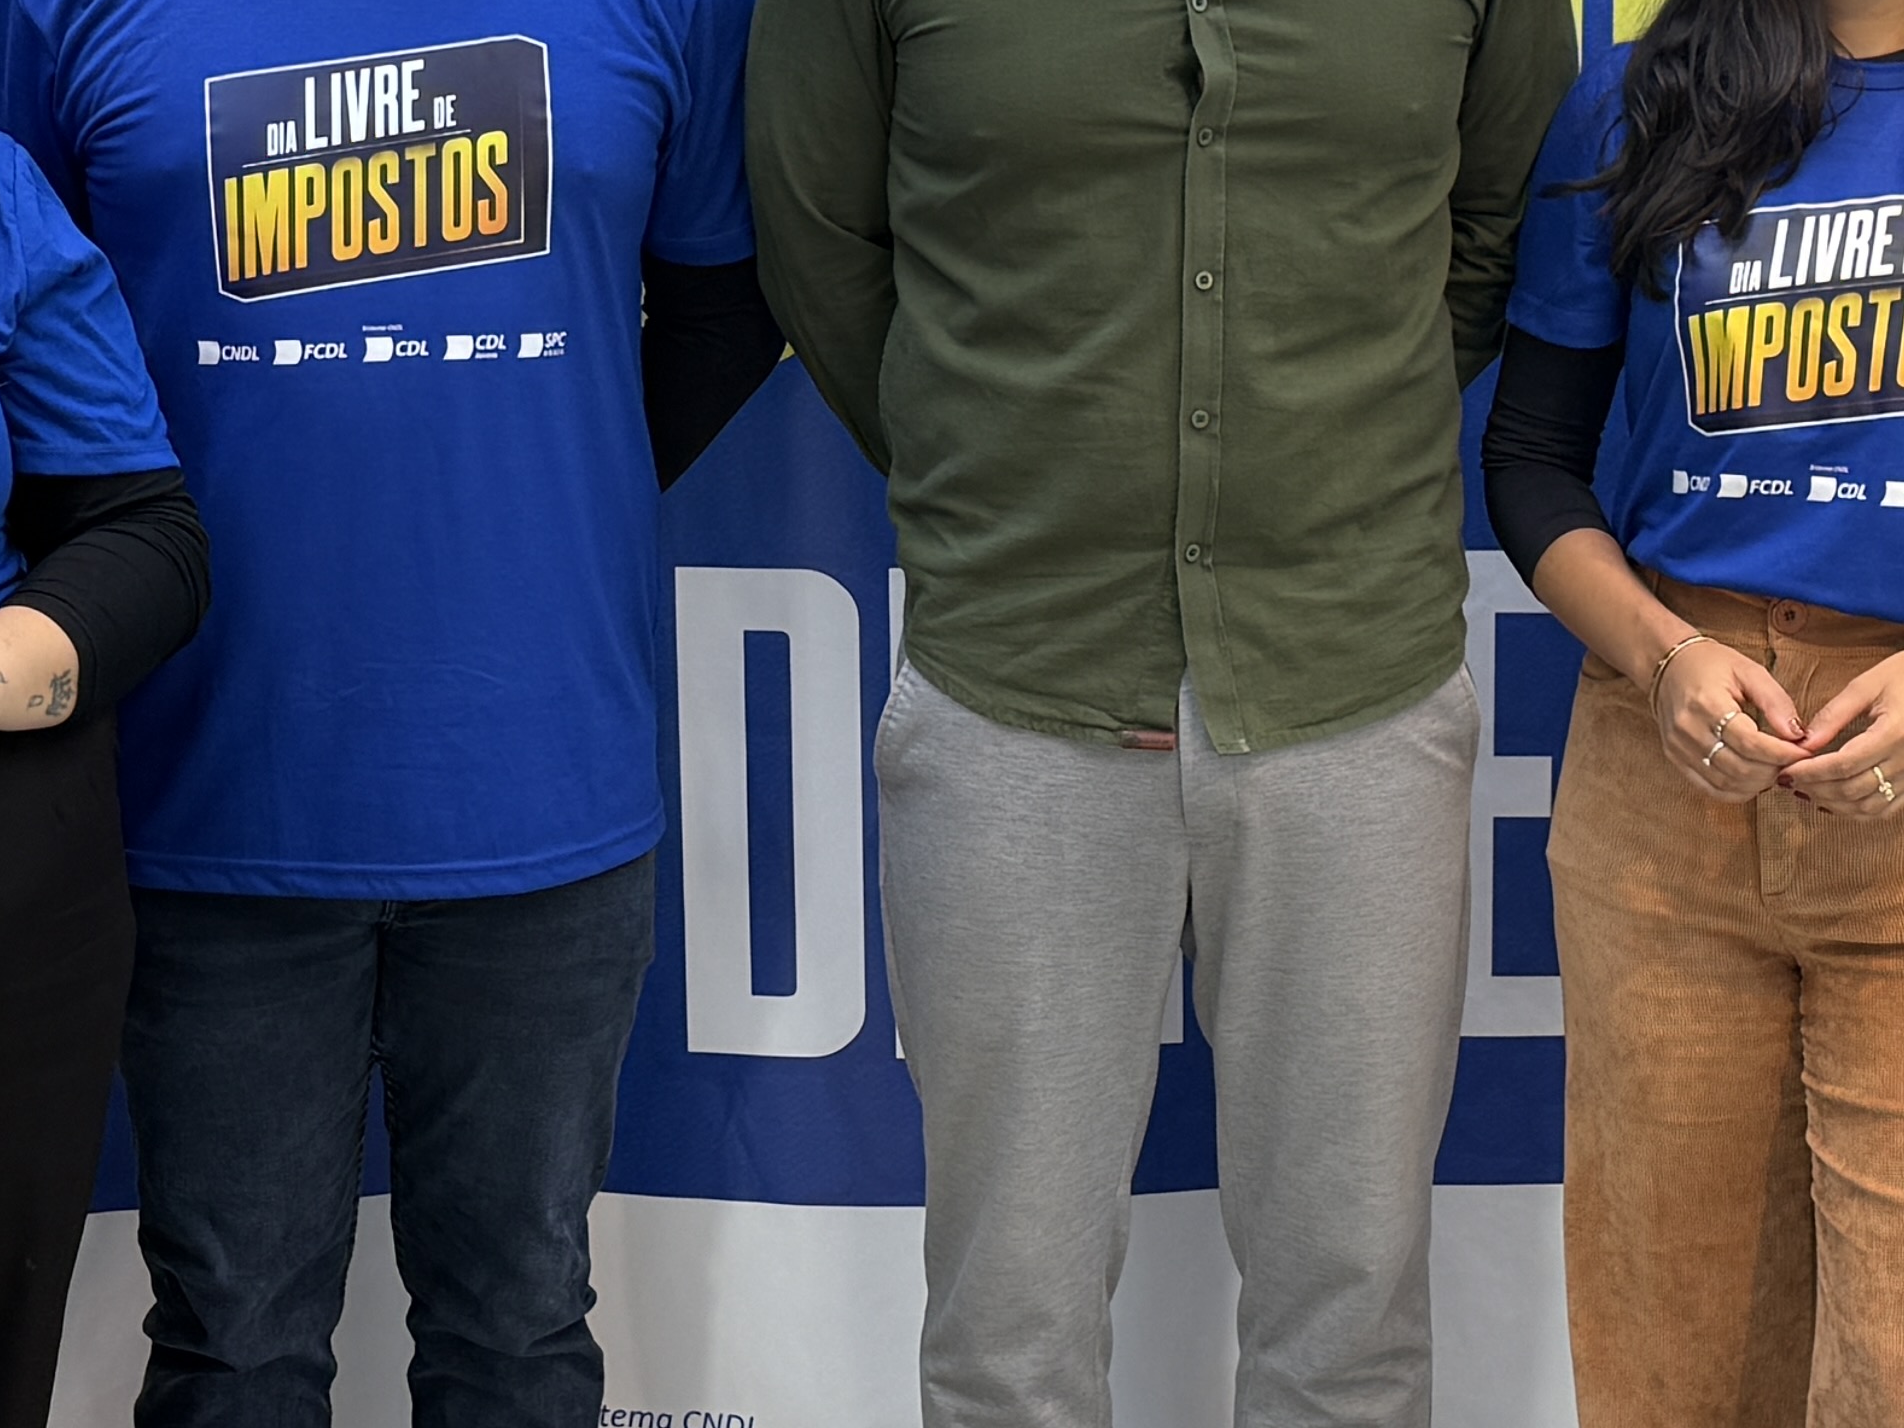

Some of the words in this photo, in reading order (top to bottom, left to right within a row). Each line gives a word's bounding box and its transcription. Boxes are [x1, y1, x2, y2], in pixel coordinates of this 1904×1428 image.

[267, 120, 296, 157] DIA
[305, 59, 425, 150] LIVRE
[433, 94, 456, 128] DE
[224, 131, 509, 283] IMPOSTOS
[1729, 260, 1762, 294] DIA
[1768, 206, 1902, 289] LIVRE
[222, 345, 260, 361] CNDL
[304, 342, 347, 360] FCDL
[396, 341, 429, 356] CDL
[475, 334, 506, 350] CDL
[545, 331, 566, 348] SPC
[1749, 479, 1793, 495] FCDL
[1837, 482, 1866, 500] CDL
